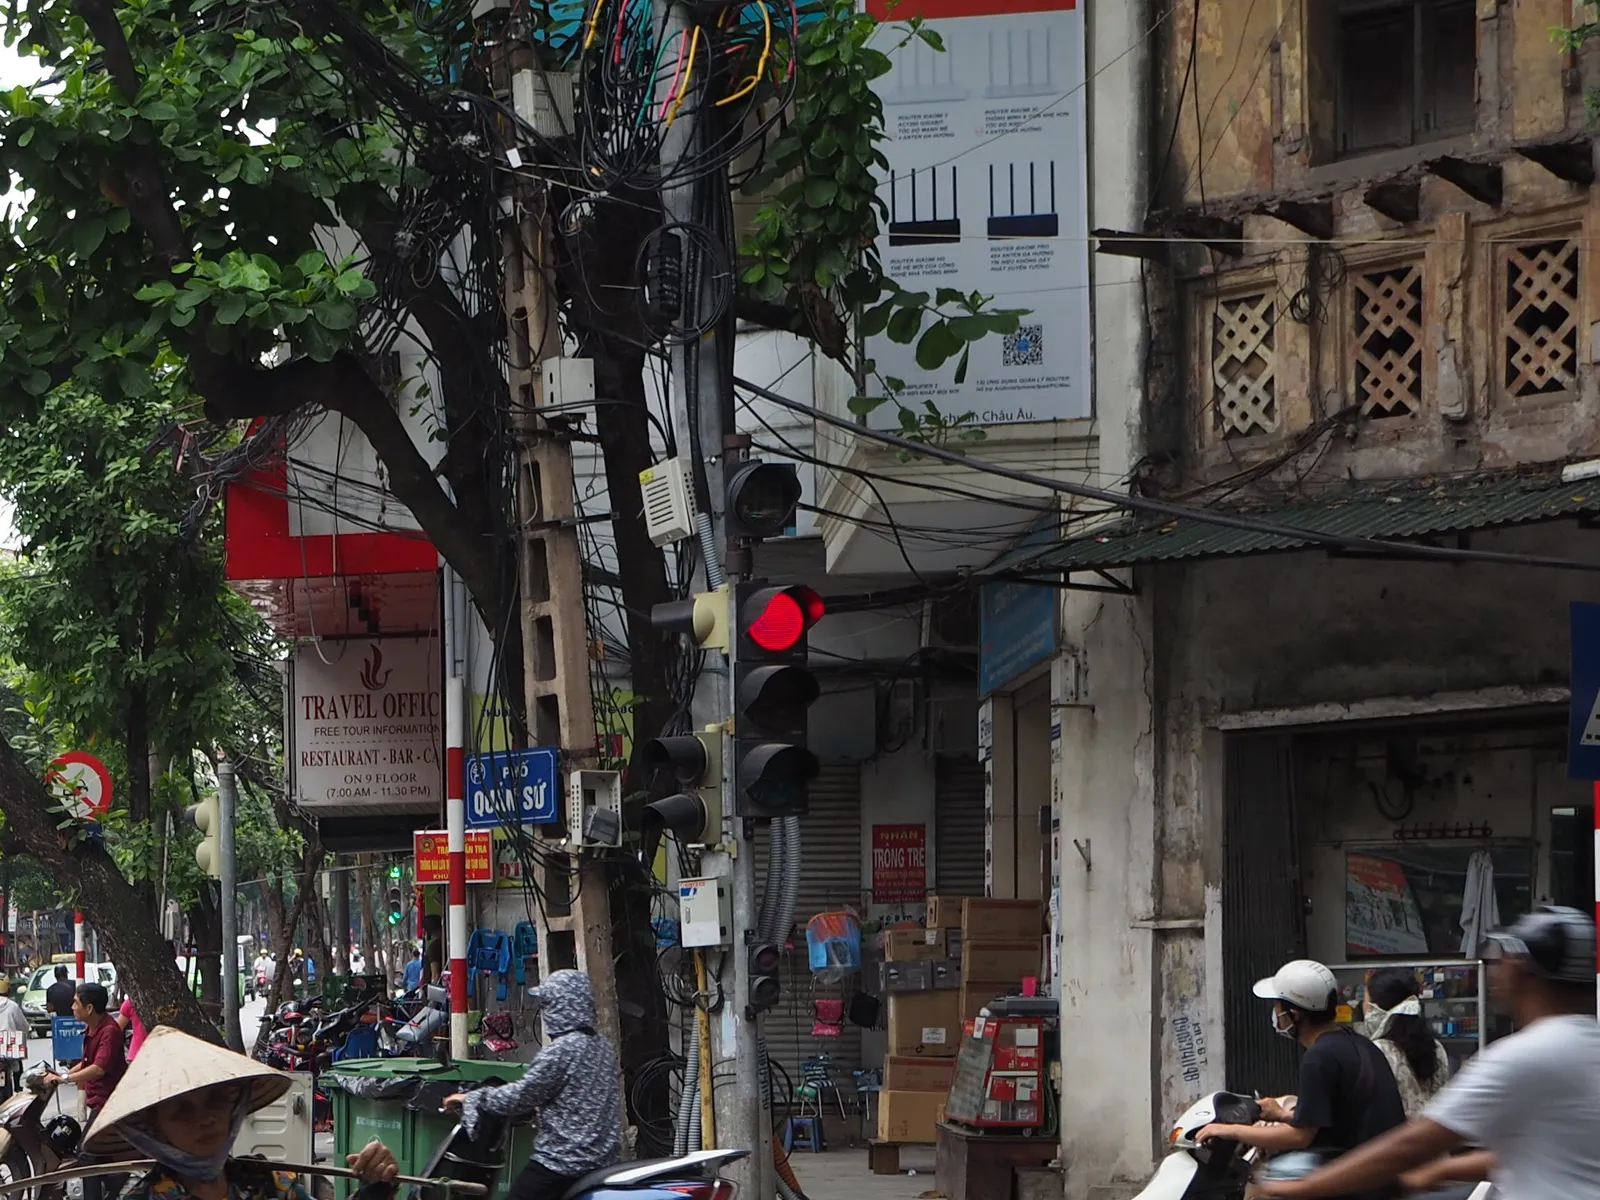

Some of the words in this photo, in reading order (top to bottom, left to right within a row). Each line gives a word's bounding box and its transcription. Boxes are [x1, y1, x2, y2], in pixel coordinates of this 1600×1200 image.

[982, 410, 1013, 422] Châu
[302, 694, 377, 720] TRAVEL
[314, 727, 340, 737] FREE
[343, 726, 370, 736] TOUR
[301, 749, 379, 767] RESTAURANT
[389, 750, 413, 764] BAR
[343, 774, 362, 784] ON
[365, 774, 372, 783] 9
[376, 773, 417, 783] FLOOR
[354, 787, 371, 797] AM
[410, 785, 431, 796] PM)
